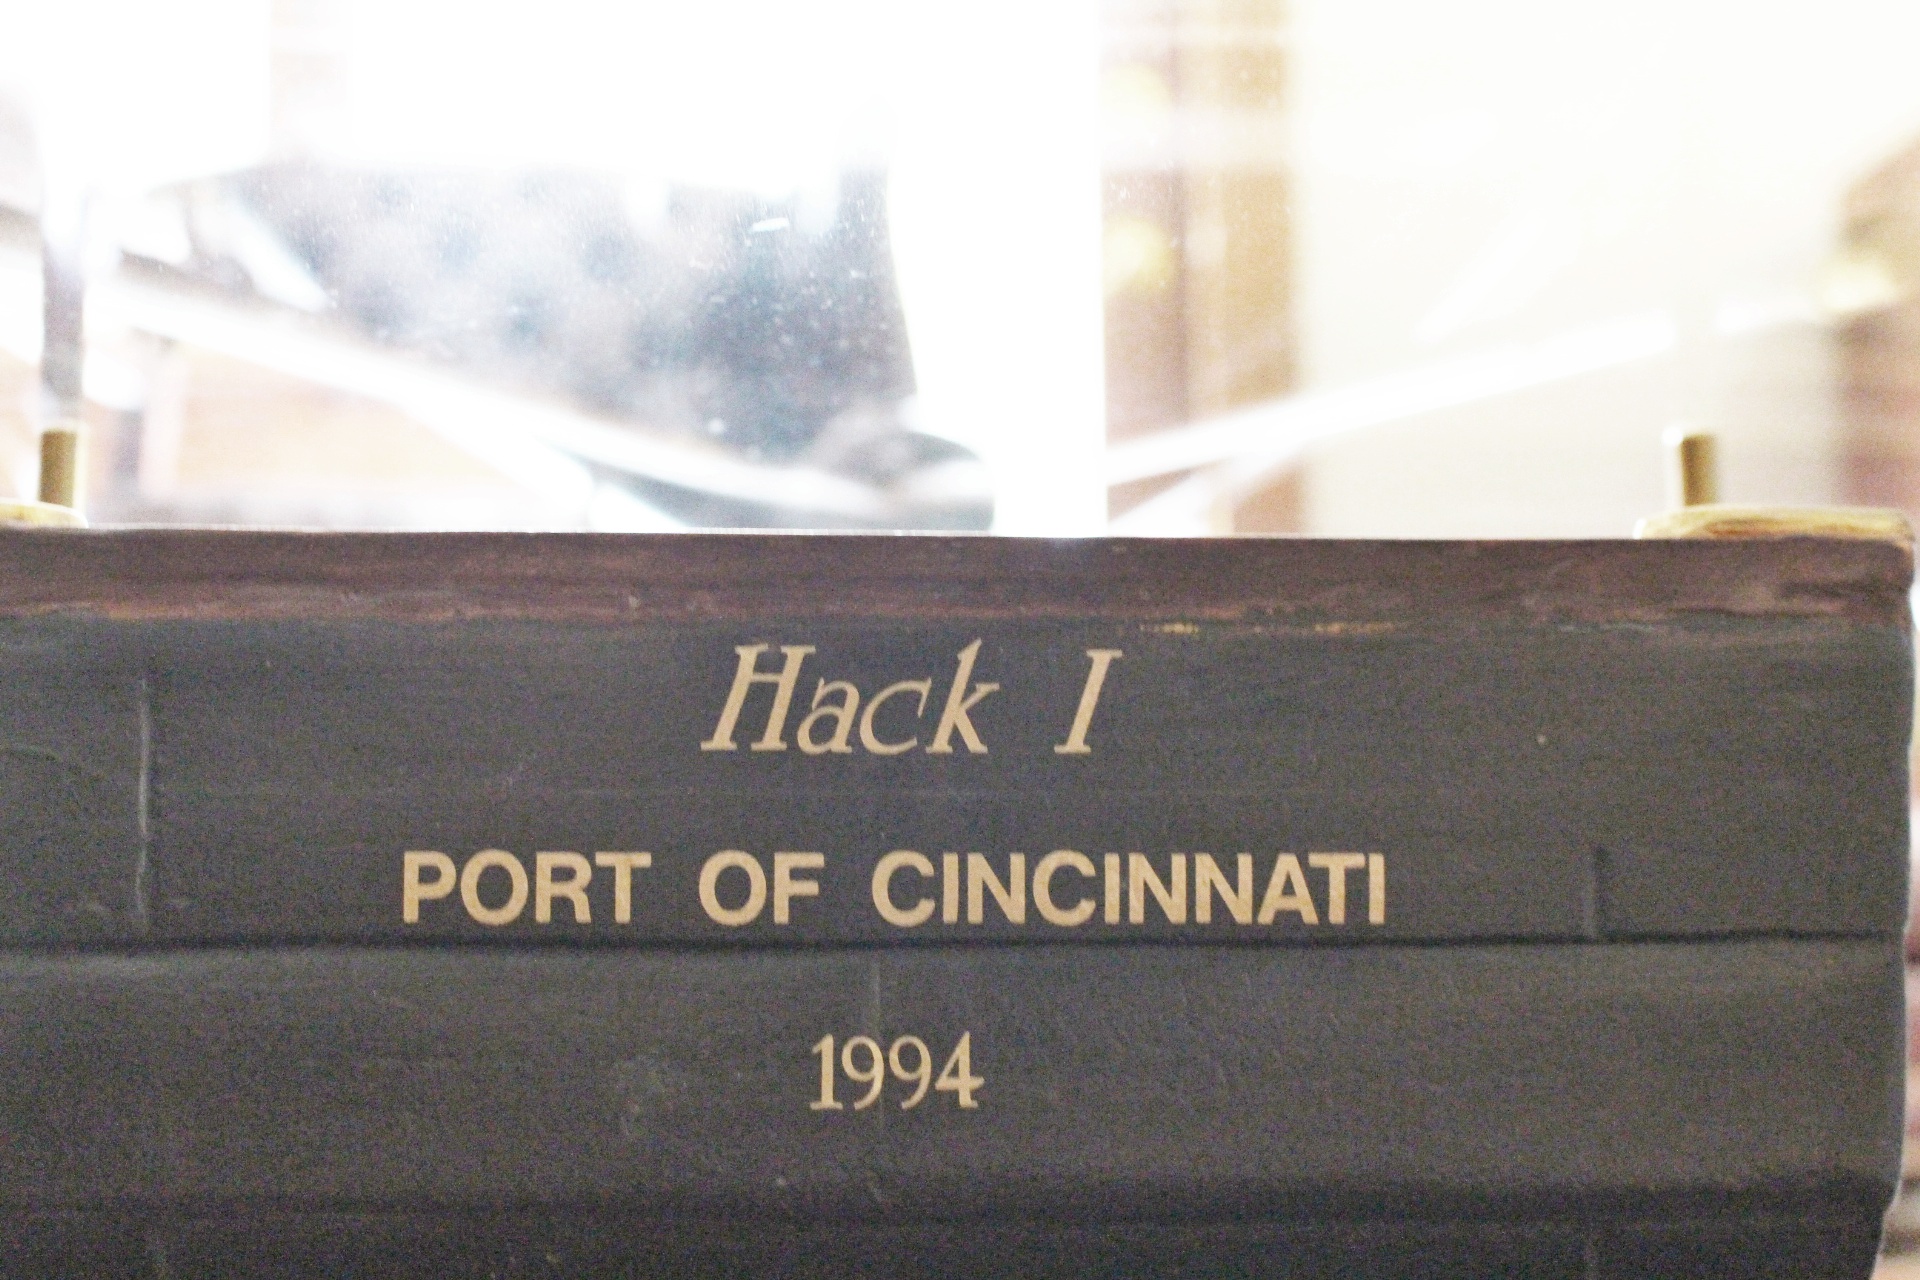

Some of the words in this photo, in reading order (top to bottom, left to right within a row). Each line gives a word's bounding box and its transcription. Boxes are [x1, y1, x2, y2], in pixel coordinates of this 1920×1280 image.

[700, 640, 1000, 755] Hack
[1054, 648, 1123, 754] I
[402, 850, 652, 926] PORT
[698, 849, 825, 926] OF
[871, 850, 1386, 927] CINCINNATI
[810, 1031, 985, 1111] 1994
